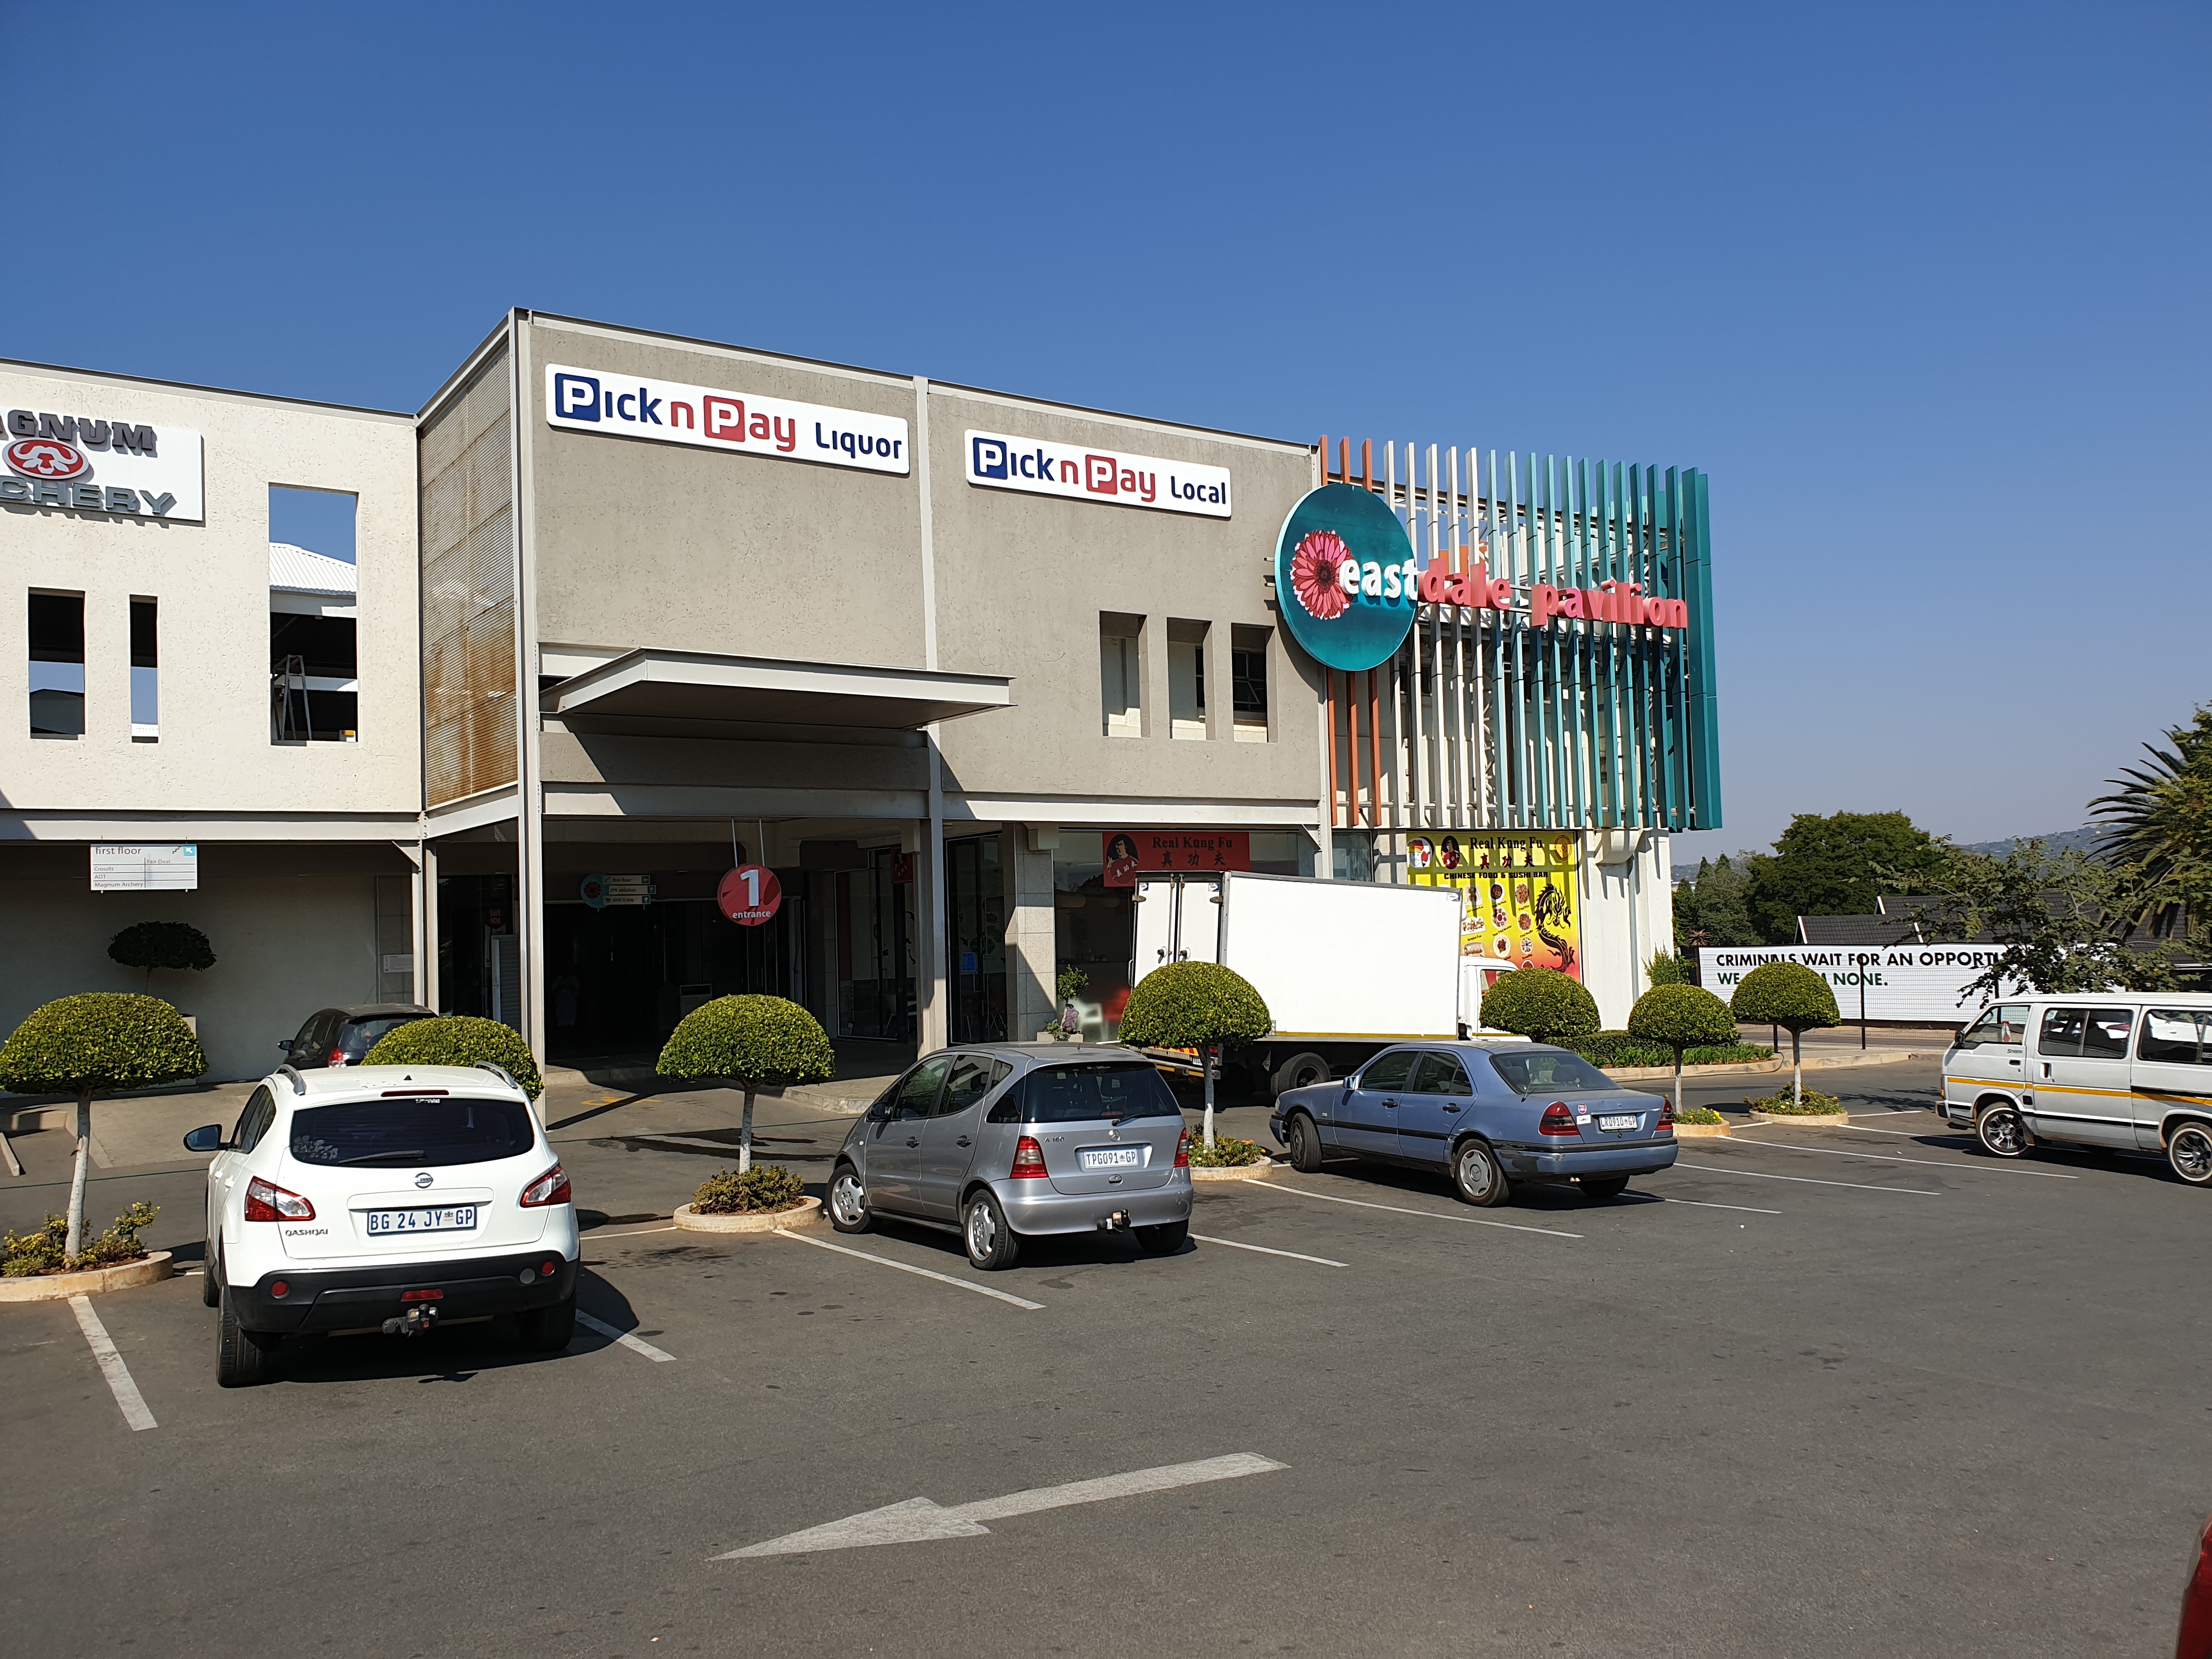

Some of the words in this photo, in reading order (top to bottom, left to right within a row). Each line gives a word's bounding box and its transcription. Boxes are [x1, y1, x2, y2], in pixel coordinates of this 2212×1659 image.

[555, 373, 663, 425] Pick
[671, 401, 694, 430] n
[703, 395, 795, 453] Pay
[815, 422, 902, 459] Liquor
[0, 409, 153, 450] GNUM
[973, 437, 1054, 482] Pick
[1060, 460, 1079, 485] n
[1085, 454, 1155, 503] Pay
[1171, 475, 1226, 505] Local
[1532, 579, 1688, 629] pavilion
[95, 847, 114, 855] first
[118, 847, 142, 855] floor
[1152, 837, 1178, 848] Real
[1183, 837, 1214, 850] Kung
[1218, 837, 1232, 848] Fu
[1470, 837, 1493, 849] Real
[1497, 837, 1526, 851] Kung
[1529, 837, 1543, 849] Fu
[1161, 850, 1226, 867] 真功夫
[1480, 853, 1535, 870] 真功夫
[740, 870, 759, 906] 1
[732, 910, 771, 918] entrance
[1802, 953, 1842, 966] WAIT
[1848, 953, 1881, 966] FOR
[1887, 952, 1913, 966] AN
[1717, 973, 1740, 985] WE
[1628, 1116, 1635, 1126] GP
[1126, 1151, 1136, 1163] GP
[371, 1214, 390, 1231] BG
[398, 1212, 416, 1229] 24
[424, 1210, 442, 1227] JY
[456, 1209, 473, 1225] GP
